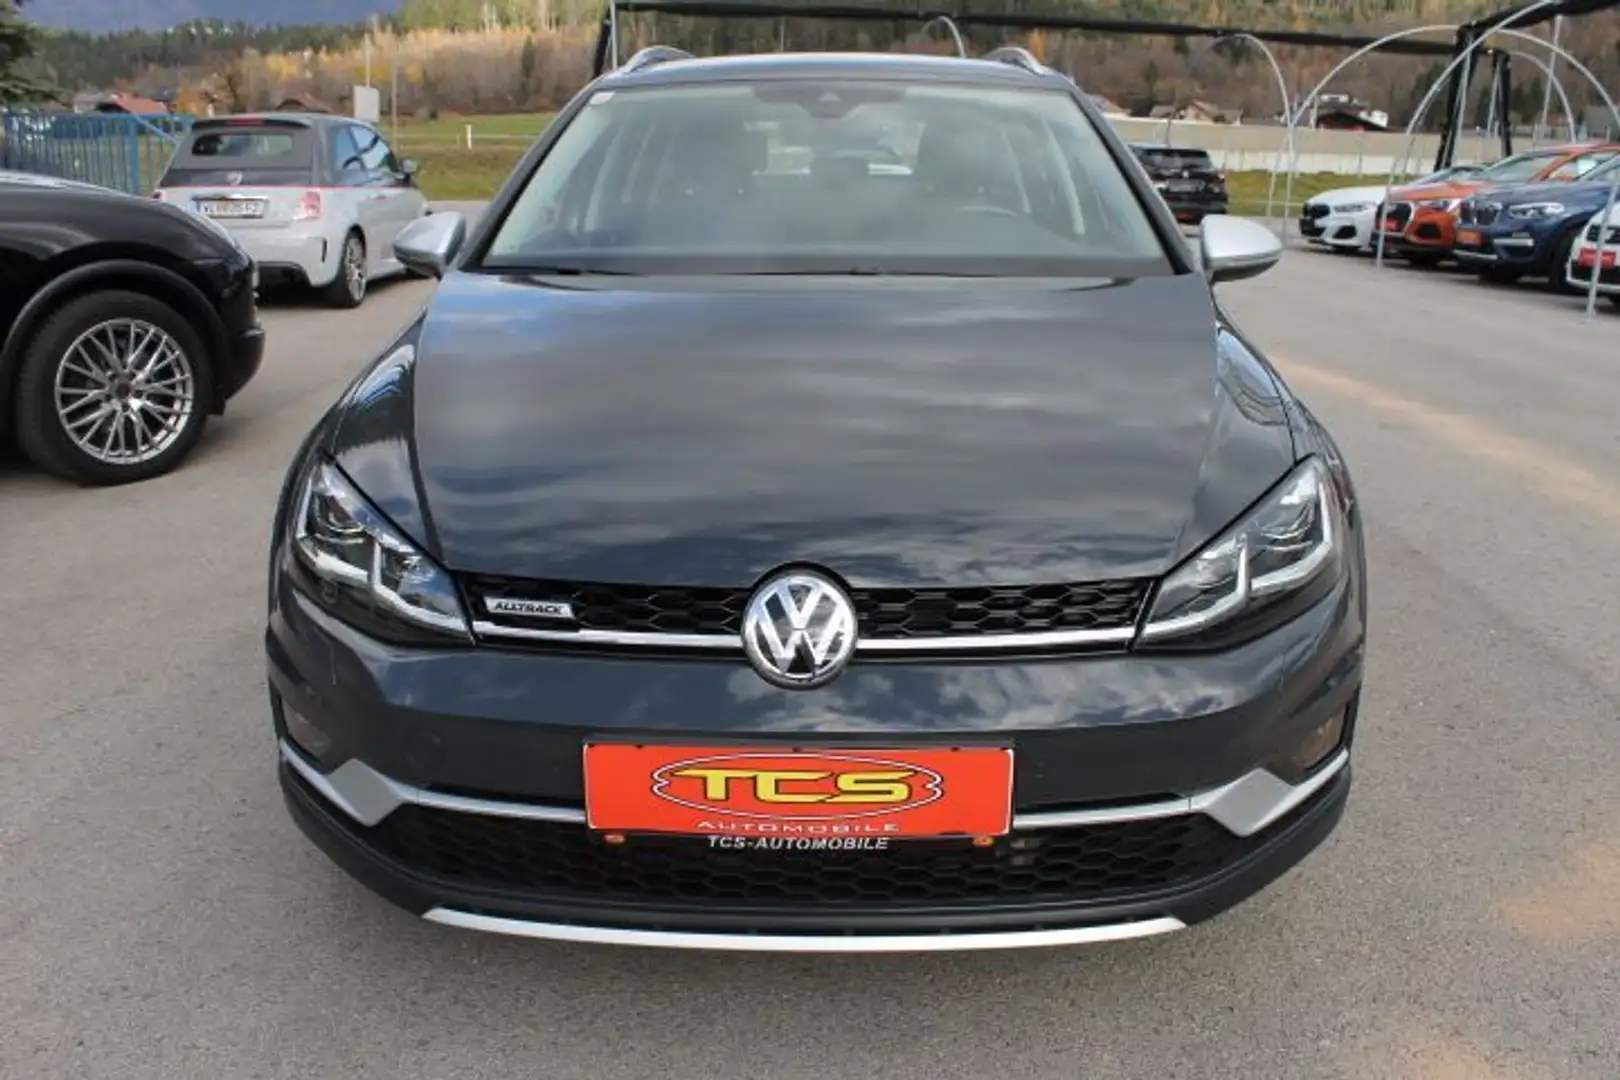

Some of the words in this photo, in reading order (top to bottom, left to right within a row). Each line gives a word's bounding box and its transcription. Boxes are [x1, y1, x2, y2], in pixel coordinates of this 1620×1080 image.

[494, 602, 564, 615] ALLTRACK
[749, 576, 852, 680] VW
[671, 768, 919, 804] TCS
[698, 820, 900, 833] AUTOMOBILE
[707, 835, 890, 850] TCS-AUTOMOBILE
